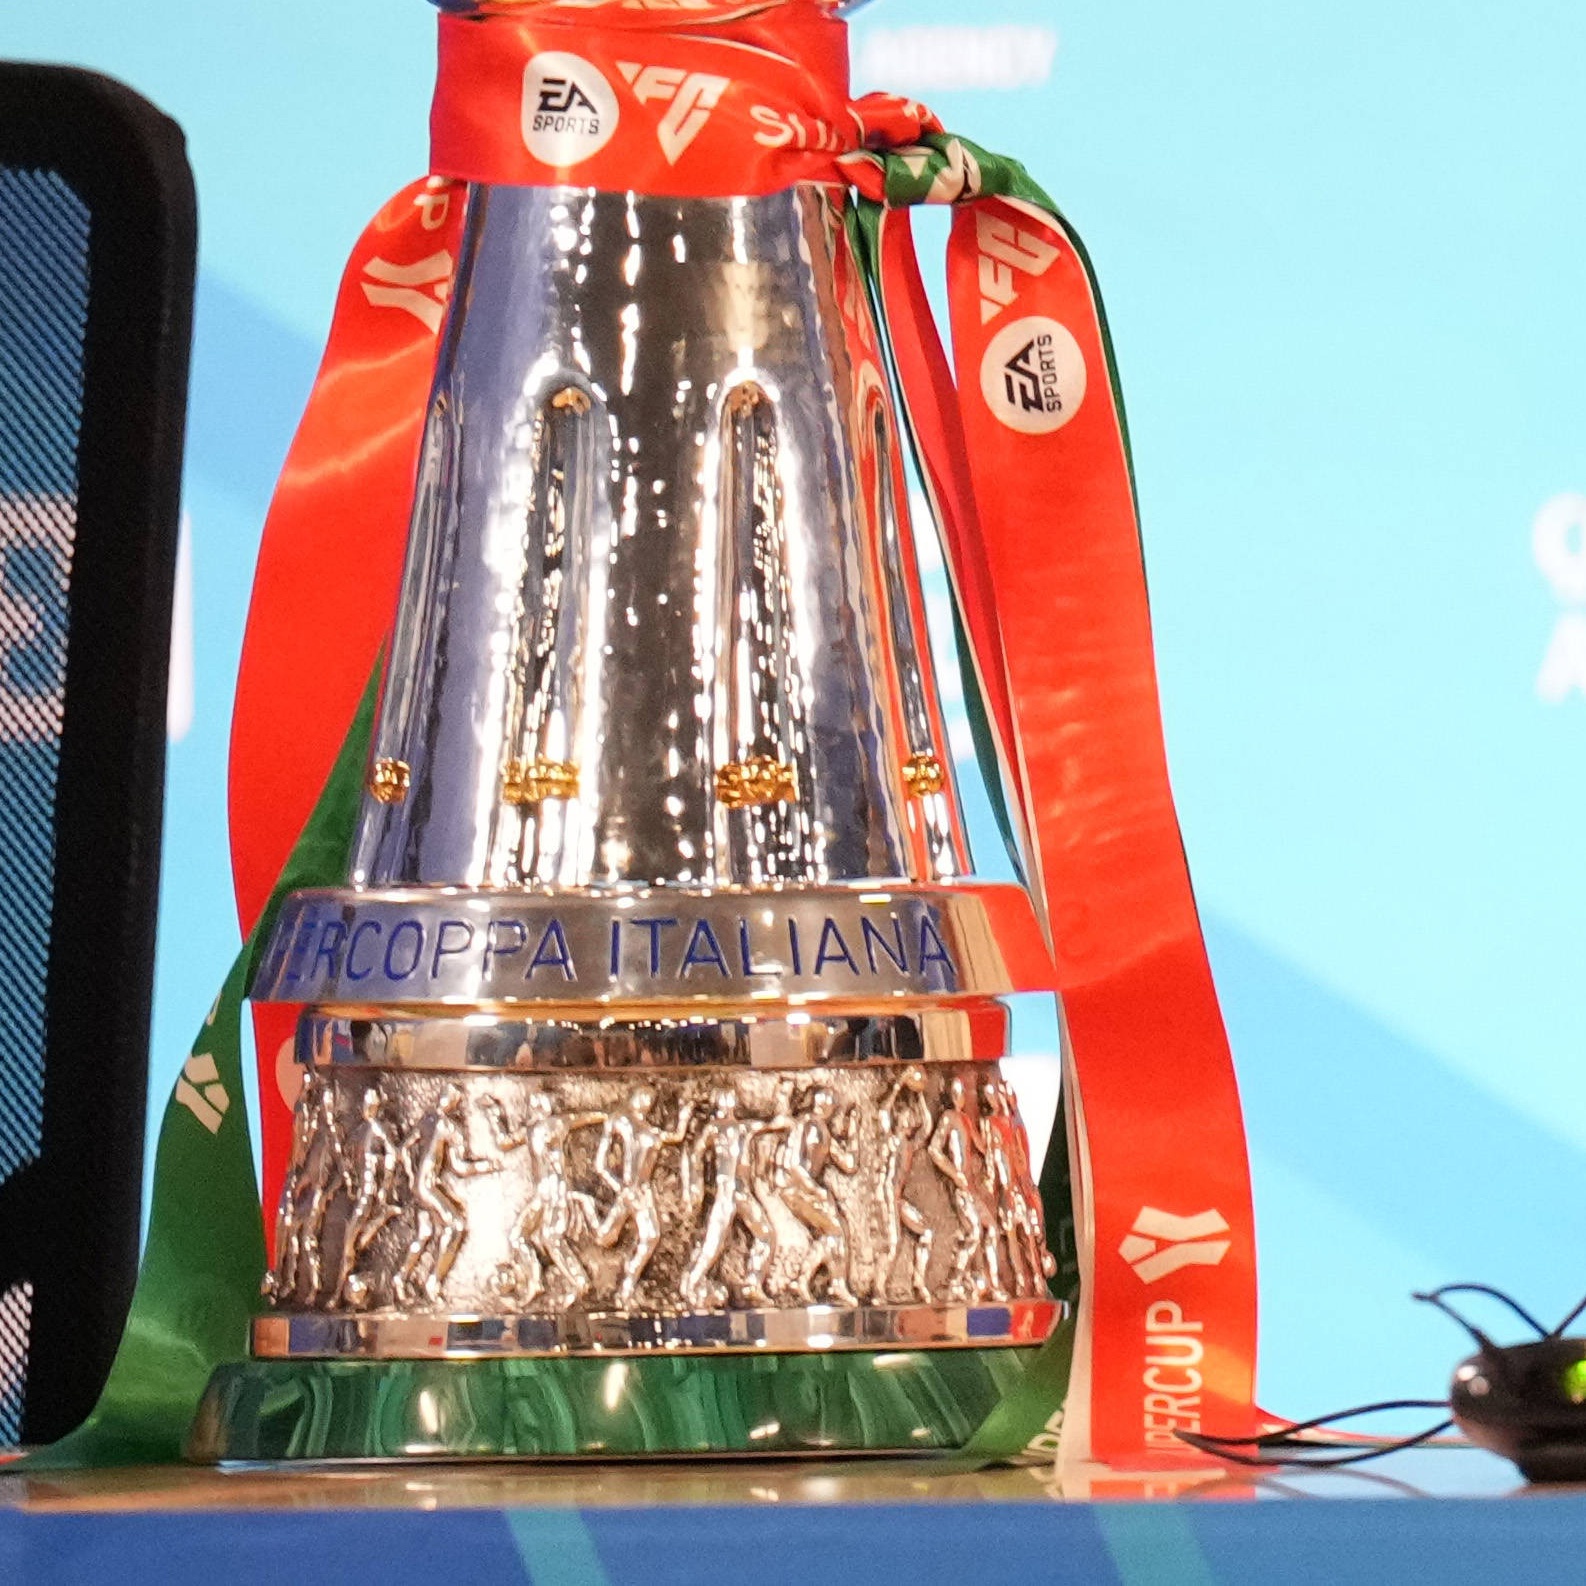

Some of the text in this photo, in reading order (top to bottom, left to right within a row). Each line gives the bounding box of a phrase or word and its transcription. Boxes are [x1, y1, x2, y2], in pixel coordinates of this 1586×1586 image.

[532, 112, 600, 136] SPORTS
[537, 77, 598, 114] EA
[1004, 337, 1044, 413] EA
[1036, 333, 1062, 414] SPORTS
[608, 916, 959, 982] ITALIANA
